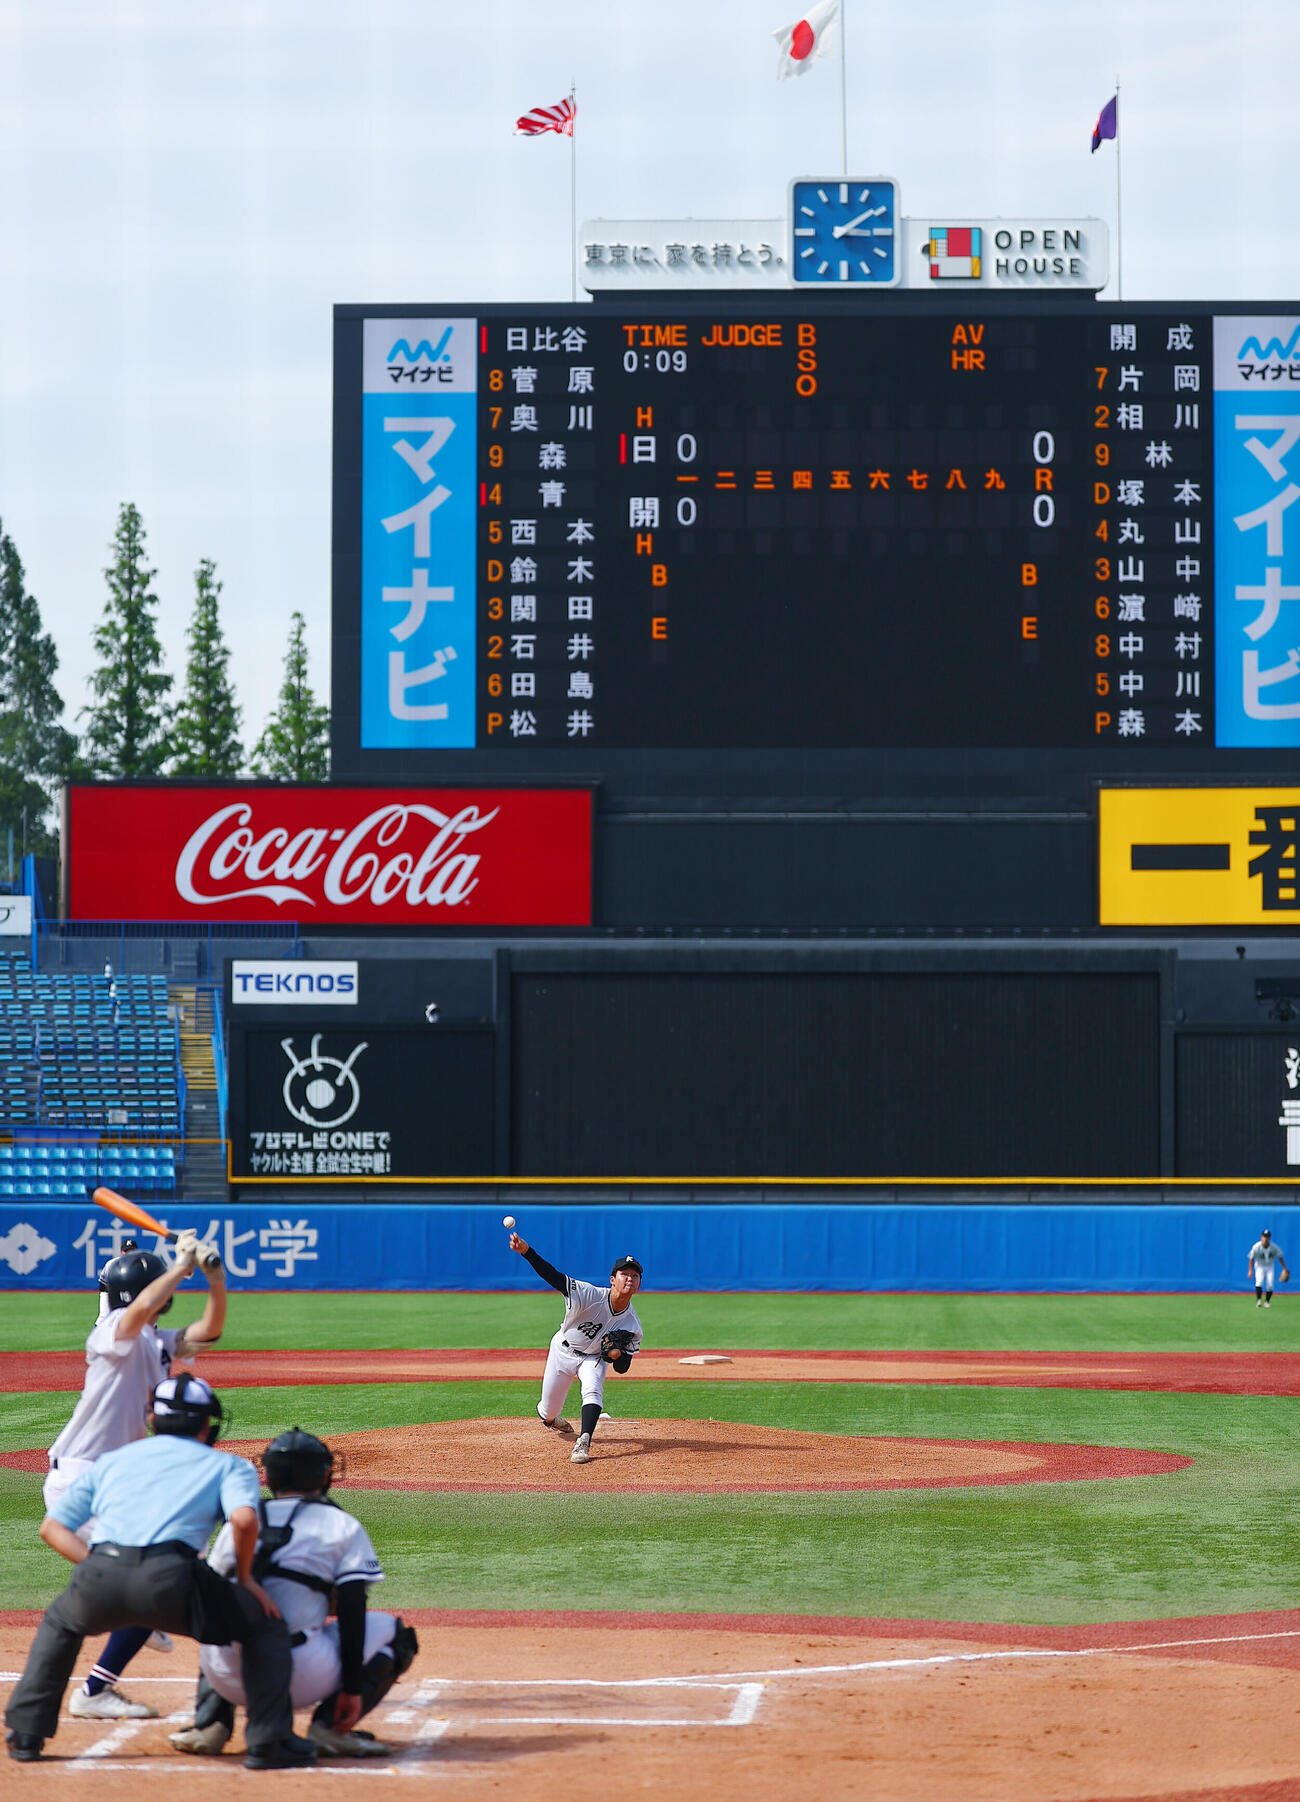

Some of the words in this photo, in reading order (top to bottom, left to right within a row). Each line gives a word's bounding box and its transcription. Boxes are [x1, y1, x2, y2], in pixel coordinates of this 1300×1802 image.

[995, 230, 1081, 249] OPEN
[585, 243, 785, 270] 東京に、家を持とう。
[996, 256, 1081, 275] HOUSE
[507, 327, 587, 352] 日比谷
[623, 325, 688, 346] TIME
[702, 325, 782, 346] JUDGE
[798, 324, 816, 346] B
[952, 324, 984, 344] AV
[1111, 323, 1193, 351] 開成
[624, 350, 686, 373] 0:09
[798, 349, 817, 372] S
[952, 350, 985, 370] HR
[1238, 364, 1300, 381] マイナビ
[387, 366, 454, 383] マイナビ
[490, 370, 503, 391] 8
[512, 366, 594, 394] 菅原
[1096, 368, 1108, 389] 7
[1118, 365, 1199, 391] 片岡
[490, 407, 502, 428] 7
[511, 404, 592, 432] 奥川
[637, 407, 652, 427] H
[1095, 406, 1109, 428] 2
[1117, 403, 1198, 430] 相川
[490, 445, 503, 467] 9
[539, 442, 566, 470] 森
[633, 436, 656, 463] 日
[677, 434, 696, 462] 0
[1033, 431, 1054, 464] 0
[1096, 444, 1109, 466] 9
[1145, 441, 1172, 468] 林
[715, 472, 736, 488] 二
[754, 471, 774, 489] 三
[793, 471, 812, 489] 四
[830, 471, 851, 489] 五
[869, 470, 890, 489] 六
[907, 470, 928, 489] 七
[946, 470, 966, 489] 八
[985, 469, 1005, 489] 九
[1036, 468, 1052, 490] R
[489, 484, 501, 504] 4
[539, 480, 566, 508] 青
[1095, 483, 1110, 504] D
[1117, 479, 1201, 506] 塚本
[630, 497, 659, 528] 開
[677, 497, 696, 525] 0
[1033, 495, 1054, 527] 0
[490, 521, 502, 543] 5
[510, 518, 594, 545] 西本
[637, 533, 652, 555] H
[1096, 520, 1107, 541] 4
[1118, 518, 1200, 544] 丸山
[381, 416, 459, 721] マイナビ
[488, 560, 503, 581] D
[510, 556, 594, 584] 鈴木
[652, 564, 667, 586] B
[1022, 564, 1037, 586] B
[1096, 558, 1110, 580] 3
[1119, 555, 1200, 582] 山中
[488, 598, 503, 620] 3
[511, 595, 592, 622] 関田
[1096, 597, 1109, 618] 6
[652, 618, 667, 639] E
[1022, 617, 1037, 639] E
[488, 636, 502, 658] 2
[511, 633, 594, 659] 石井
[1096, 635, 1109, 657] 8
[1120, 632, 1202, 659] 中村
[488, 674, 502, 696] 6
[512, 671, 593, 699] 田島
[1097, 673, 1109, 696] 5
[1120, 670, 1199, 697] 中川
[488, 713, 502, 734] P
[510, 709, 594, 737] 松井
[1096, 712, 1110, 733] P
[1118, 708, 1202, 736] 森本
[175, 803, 500, 906] Coca-Cola
[234, 973, 355, 993] TEKNOS
[250, 1131, 391, 1150] フジテレビONEで
